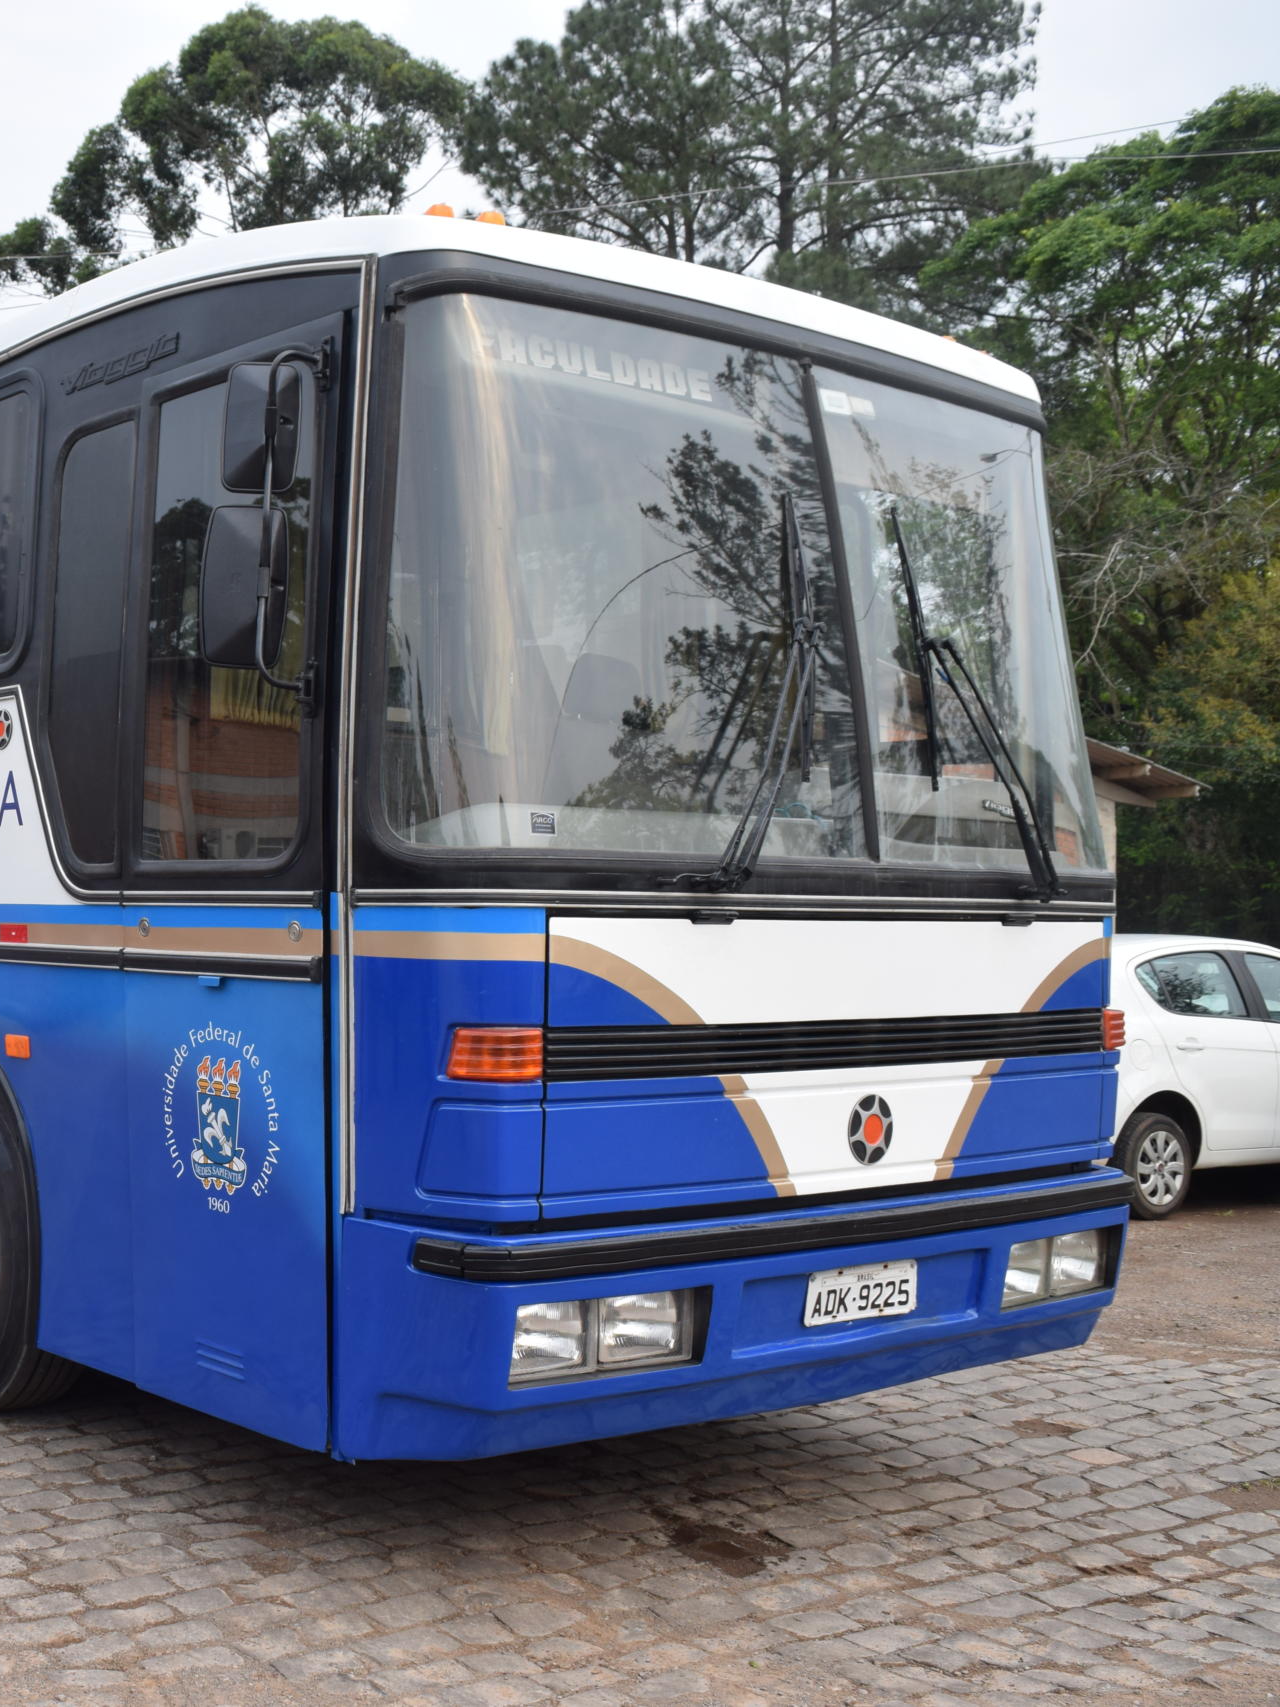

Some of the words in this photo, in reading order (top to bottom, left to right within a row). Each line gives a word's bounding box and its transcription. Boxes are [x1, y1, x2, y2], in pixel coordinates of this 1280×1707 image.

[188, 1020, 242, 1048] Federal
[242, 1043, 261, 1069] de
[163, 1043, 190, 1179] Universidade
[258, 1069, 280, 1132] Santa
[251, 1139, 281, 1197] Maria
[207, 1196, 230, 1214] 1960
